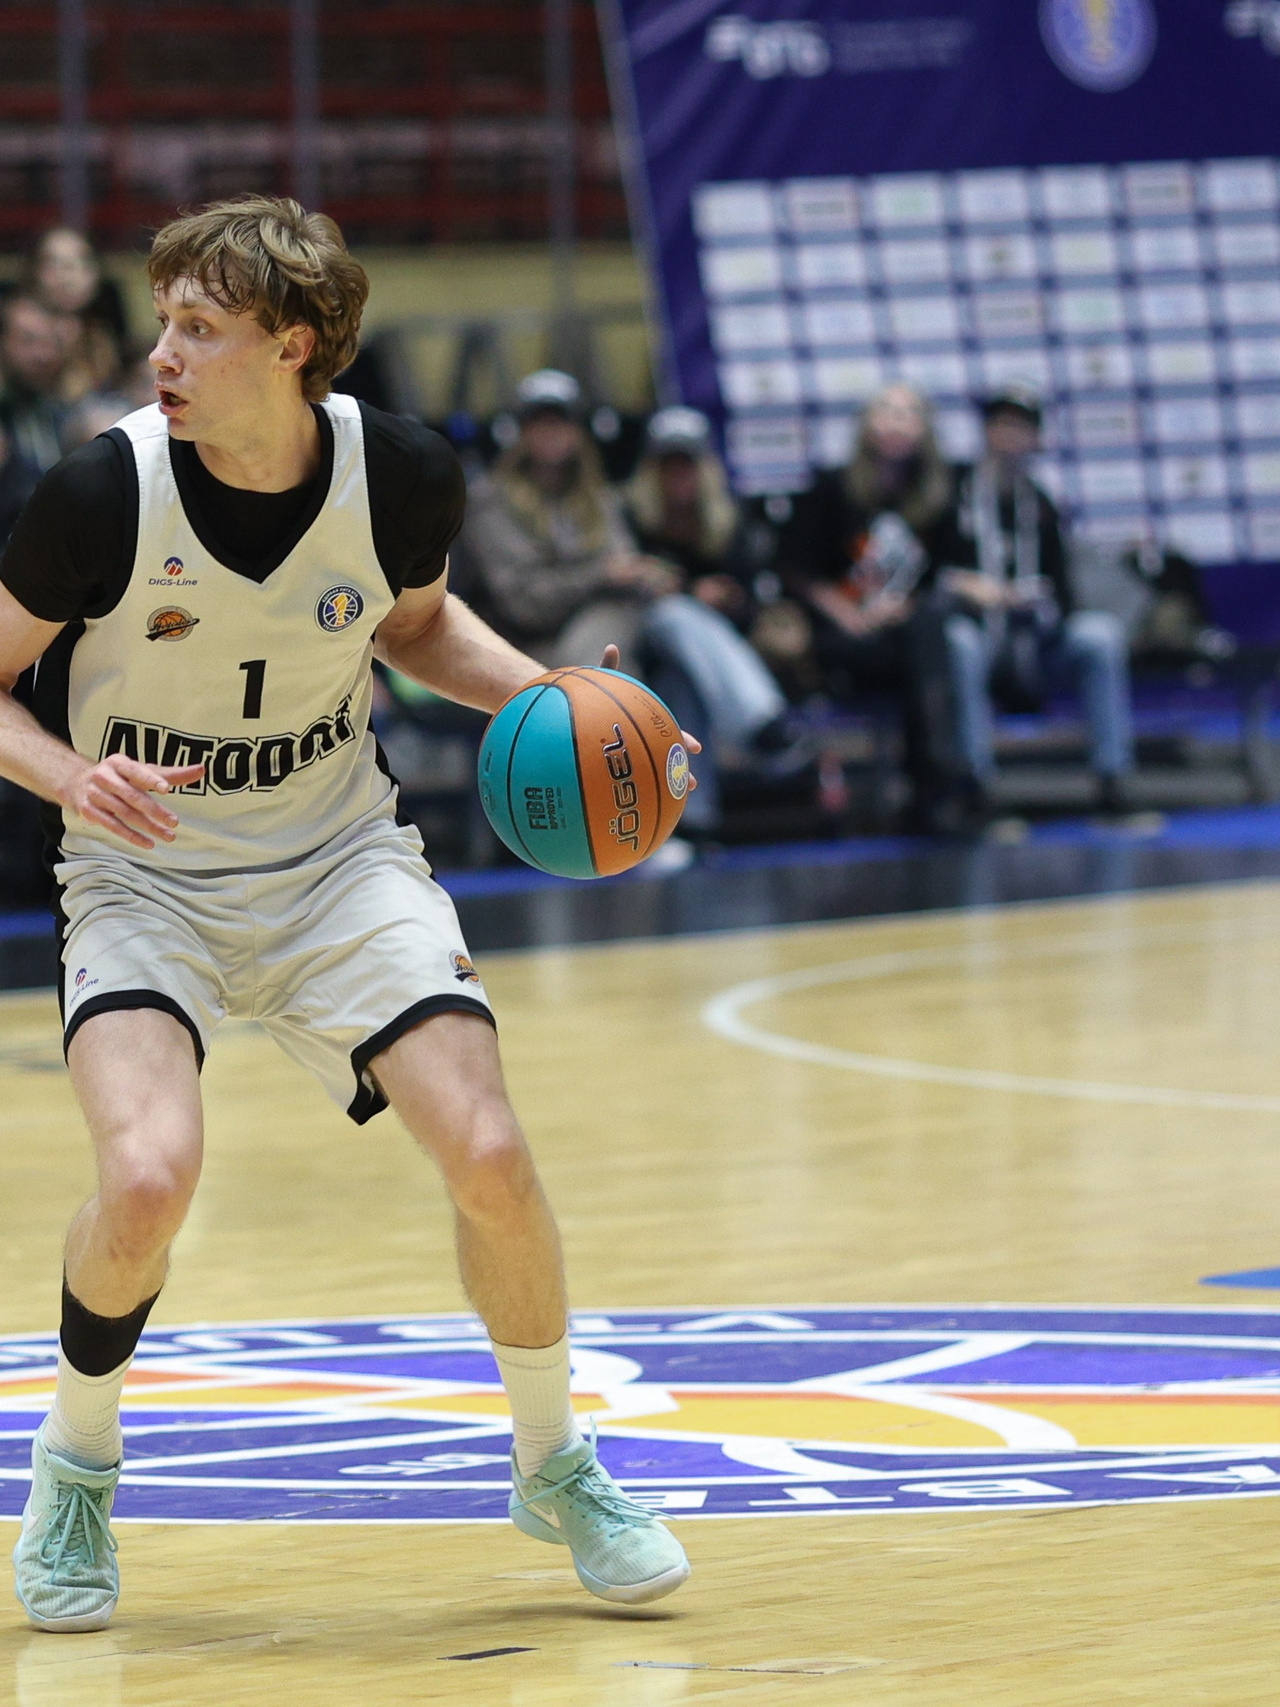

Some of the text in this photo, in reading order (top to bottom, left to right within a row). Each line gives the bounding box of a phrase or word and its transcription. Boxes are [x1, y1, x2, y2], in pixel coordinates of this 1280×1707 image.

[148, 578, 198, 586] DIGS-Line
[238, 659, 266, 719] 1
[523, 787, 548, 830] FIBA
[545, 787, 559, 831] APPROVED
[603, 722, 640, 852] JÖGEL
